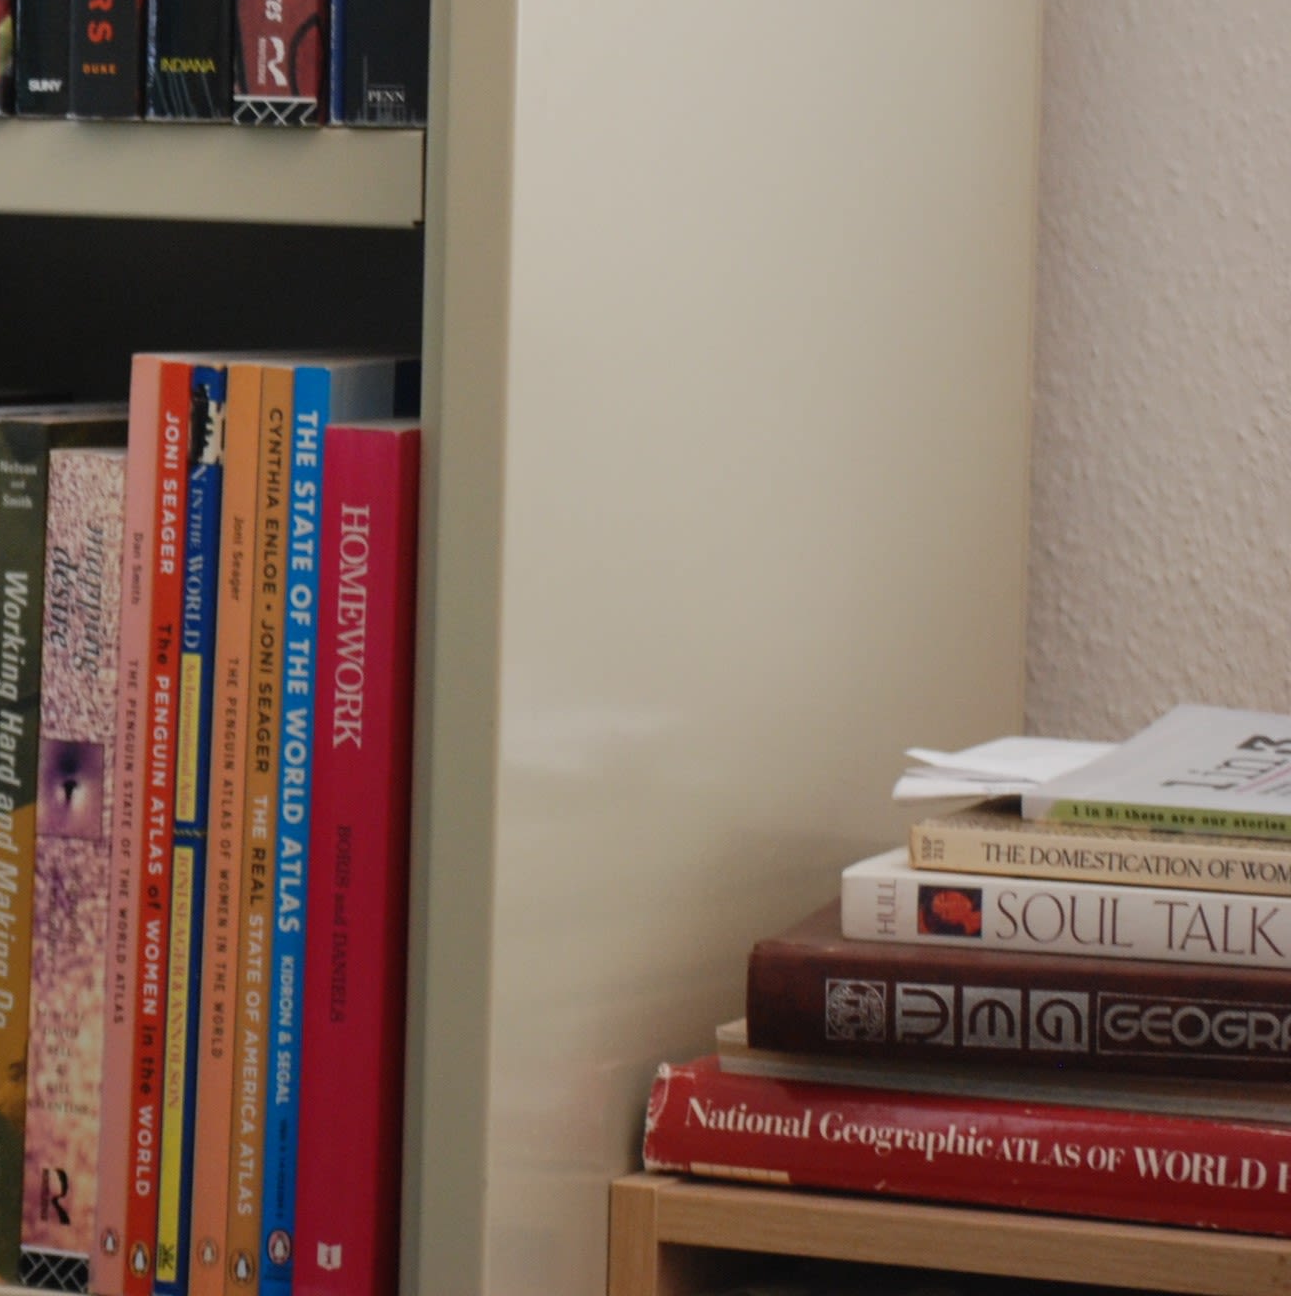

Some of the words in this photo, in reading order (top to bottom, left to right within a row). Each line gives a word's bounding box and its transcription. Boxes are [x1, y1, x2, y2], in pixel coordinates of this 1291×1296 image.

[162, 410, 180, 471] JONI
[265, 407, 285, 509] CYNTHIA
[294, 411, 319, 466] THE
[159, 479, 178, 575] SEAGER
[262, 518, 281, 595] ENLOE
[290, 478, 316, 571] STATE
[288, 582, 313, 623] OF
[331, 505, 369, 750] HOMEWORK
[259, 618, 277, 672] JONI
[286, 637, 310, 695] THE
[150, 676, 169, 785] PENGUIN
[255, 680, 275, 774] SEAGER
[282, 708, 309, 823] WORLD
[147, 798, 165, 875] ATLAS
[252, 795, 270, 839] THE
[1085, 806, 1100, 818] in
[1124, 808, 1165, 822] these
[1171, 812, 1195, 825] are
[1201, 814, 1226, 826] our
[1232, 815, 1286, 831] stories
[250, 849, 269, 905] REAL
[279, 838, 305, 931] ATLAS
[982, 842, 1024, 865] THE
[1030, 844, 1202, 877] DOMESTICATION
[1208, 859, 1236, 878] OF
[876, 879, 897, 935] HULL
[996, 891, 1132, 947] SOUL
[1153, 899, 1286, 958] TALK
[142, 920, 160, 1014] WOMEN
[247, 915, 266, 984] STATE
[245, 988, 262, 1018] OF
[276, 956, 294, 1027] KIDRON
[275, 1033, 291, 1045] &
[241, 1029, 261, 1136] AMERICA
[274, 1050, 290, 1104] SEGAL
[135, 1106, 153, 1196] WORLD
[237, 1143, 256, 1215] ATLAS
[685, 1097, 811, 1139] National
[818, 1112, 994, 1162] Geographic
[995, 1138, 1081, 1167] ATLAS
[1087, 1145, 1125, 1171] OF
[1134, 1146, 1267, 1191] WORLD
